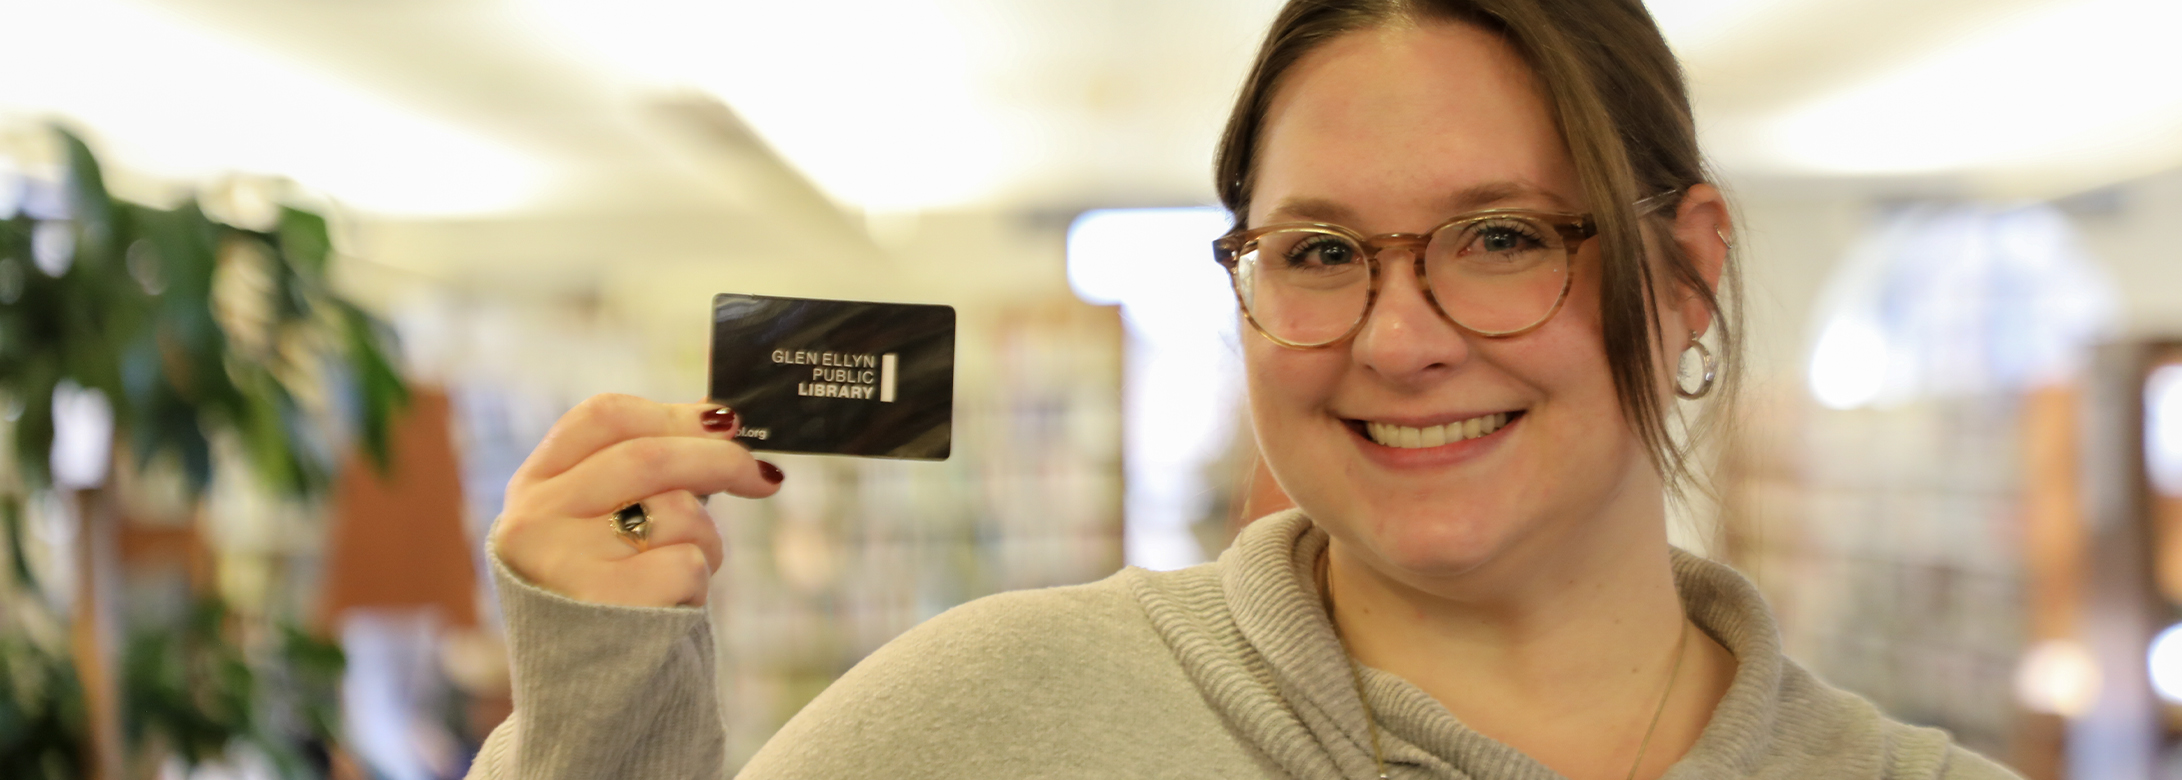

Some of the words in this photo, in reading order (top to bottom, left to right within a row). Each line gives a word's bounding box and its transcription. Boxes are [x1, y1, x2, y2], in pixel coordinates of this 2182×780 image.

[771, 349, 818, 365] GLEN
[822, 352, 875, 368] ELLYN
[812, 367, 875, 384] PUBLIC
[798, 381, 874, 400] LIBRARY
[735, 426, 768, 440] pl.org
